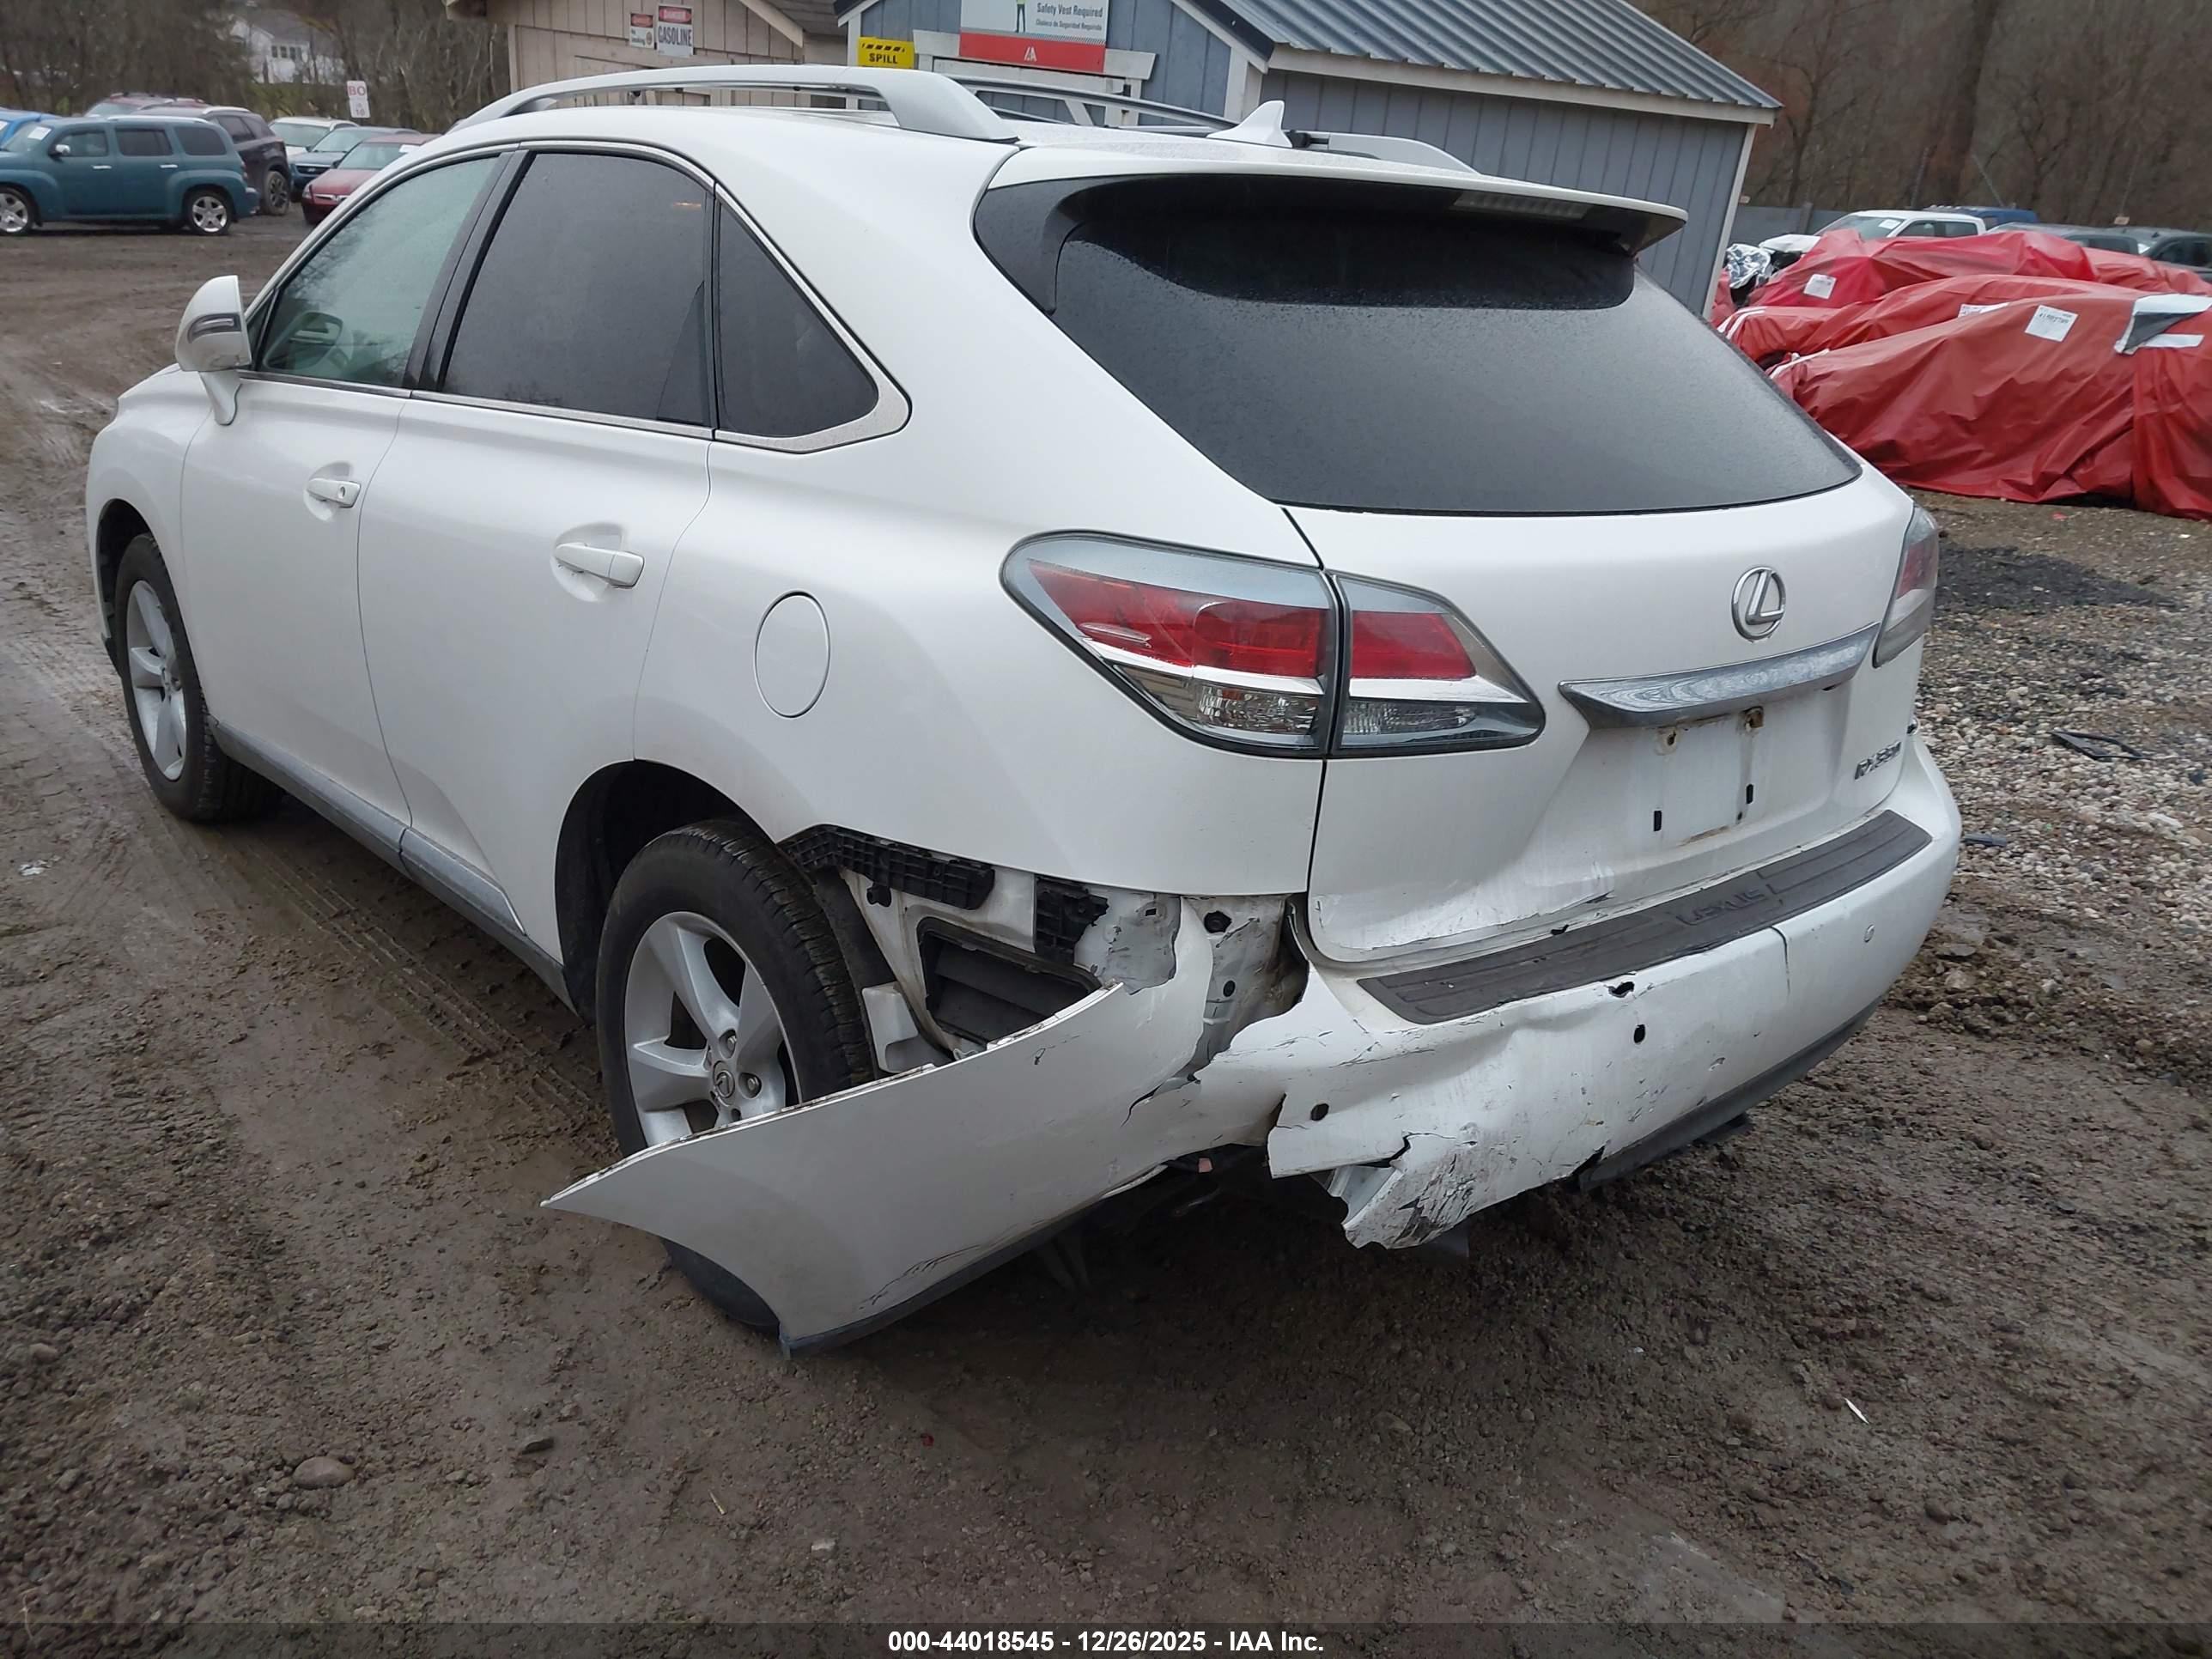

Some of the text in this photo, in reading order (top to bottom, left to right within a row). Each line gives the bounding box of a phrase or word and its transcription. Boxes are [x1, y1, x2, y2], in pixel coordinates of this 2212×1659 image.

[1036, 3, 1103, 18] Safety Vest Required
[658, 26, 692, 46] GASOLINE
[869, 52, 898, 64] SPILL
